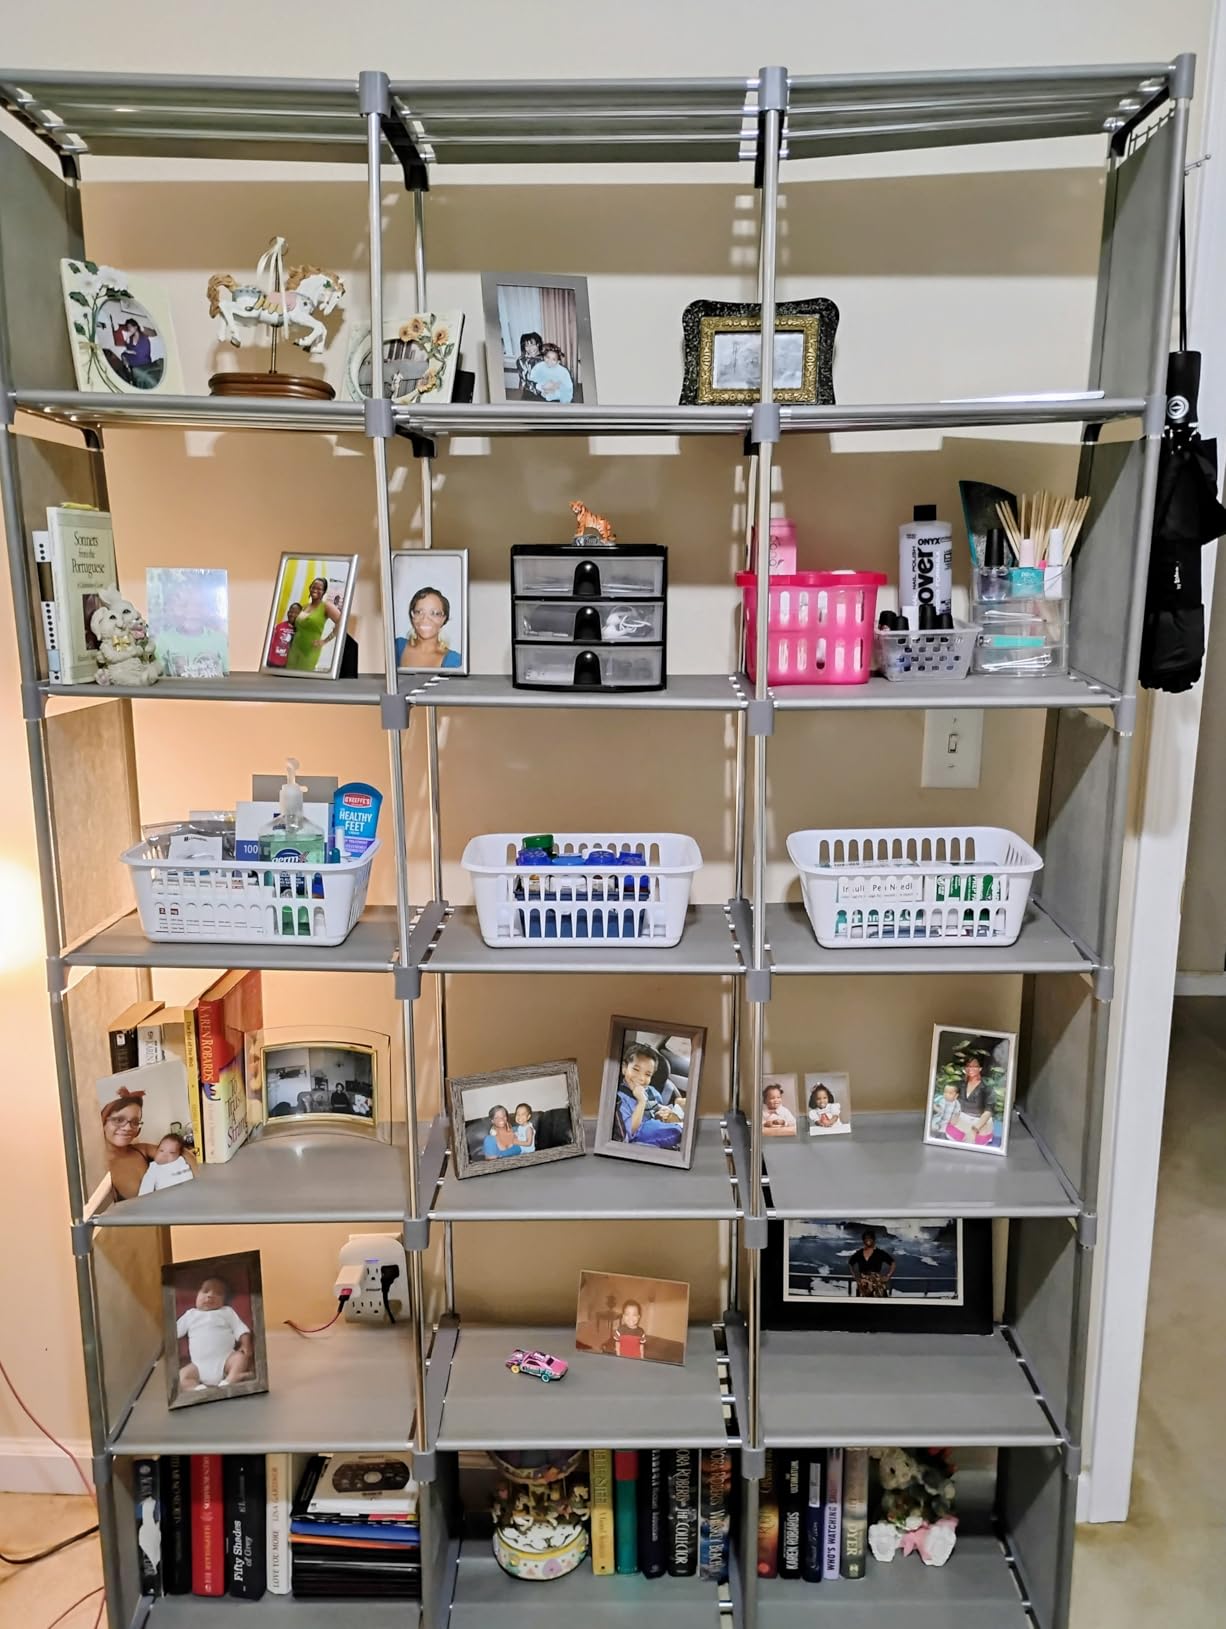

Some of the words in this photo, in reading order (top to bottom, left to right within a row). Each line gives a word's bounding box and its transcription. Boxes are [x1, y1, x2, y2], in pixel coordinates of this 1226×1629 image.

[74, 530, 99, 547] Sonnets
[917, 537, 941, 546] ONYX
[72, 558, 105, 577] Portuguese
[917, 546, 934, 606] over
[339, 810, 373, 823] HEALTHY
[345, 821, 365, 832] FEET
[243, 844, 258, 854] 100
[199, 1005, 211, 1039] KAREN
[201, 1039, 215, 1082] ROBARDS
[676, 1449, 690, 1467] ORA
[710, 1449, 727, 1469] NORA
[271, 1467, 279, 1504] GARDNER
[674, 1468, 692, 1503] ROBERTS
[790, 1459, 799, 1494] ULTIMATUM
[708, 1472, 726, 1506] ROBERTS
[271, 1505, 279, 1522] LISA
[709, 1509, 726, 1542] WHISKEY
[827, 1506, 837, 1545] WATCHING
[232, 1519, 243, 1556] Shades
[786, 1511, 800, 1546] ROBARDS
[846, 1523, 859, 1556] DYER
[244, 1535, 253, 1557] Grey
[271, 1530, 279, 1552] MORE
[674, 1522, 690, 1564] COLLECTOR
[245, 1557, 253, 1567] of
[272, 1553, 280, 1567] YOU
[709, 1543, 725, 1568] BEACH
[786, 1546, 799, 1570] KAREN
[827, 1547, 836, 1571] WHO'S
[233, 1557, 245, 1582] Fifty
[272, 1569, 280, 1588] LOVE
